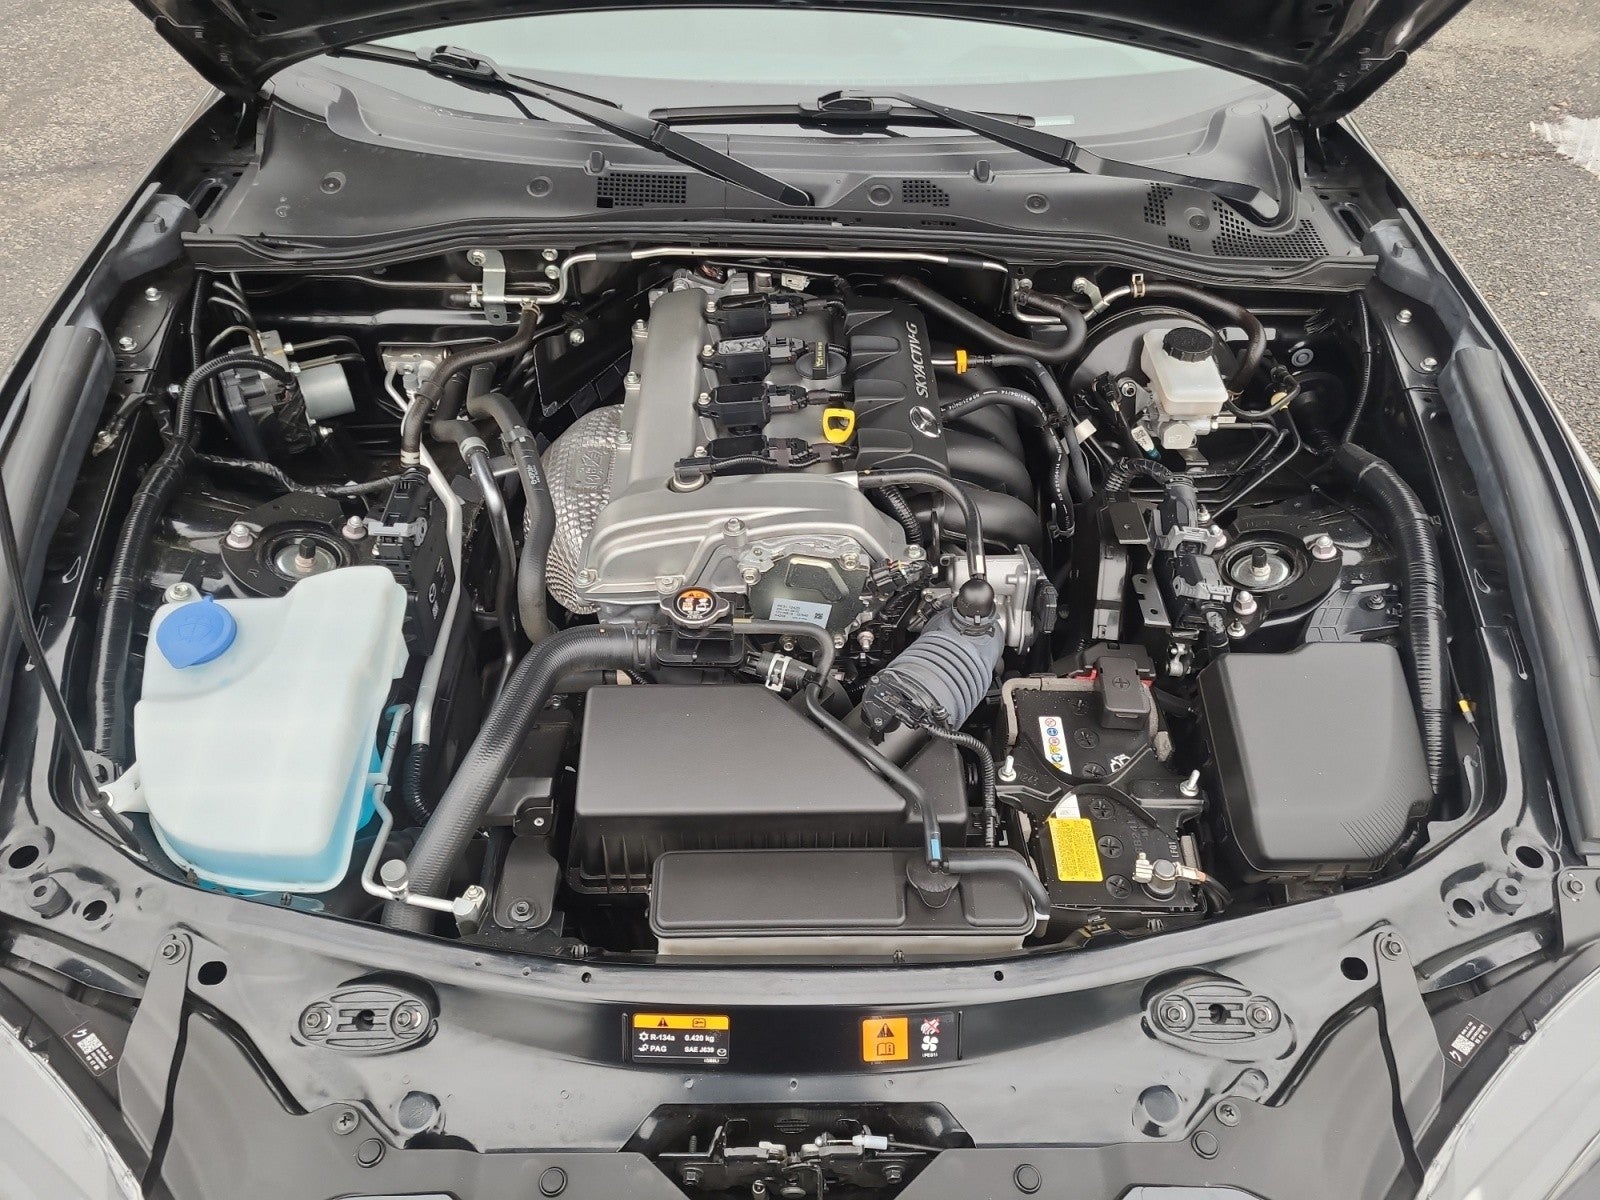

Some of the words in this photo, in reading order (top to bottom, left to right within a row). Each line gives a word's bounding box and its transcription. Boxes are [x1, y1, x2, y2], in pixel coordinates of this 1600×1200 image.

[906, 321, 928, 398] SKYACTIV-G
[684, 1034, 704, 1042] 0.420
[705, 1035, 715, 1043] kg
